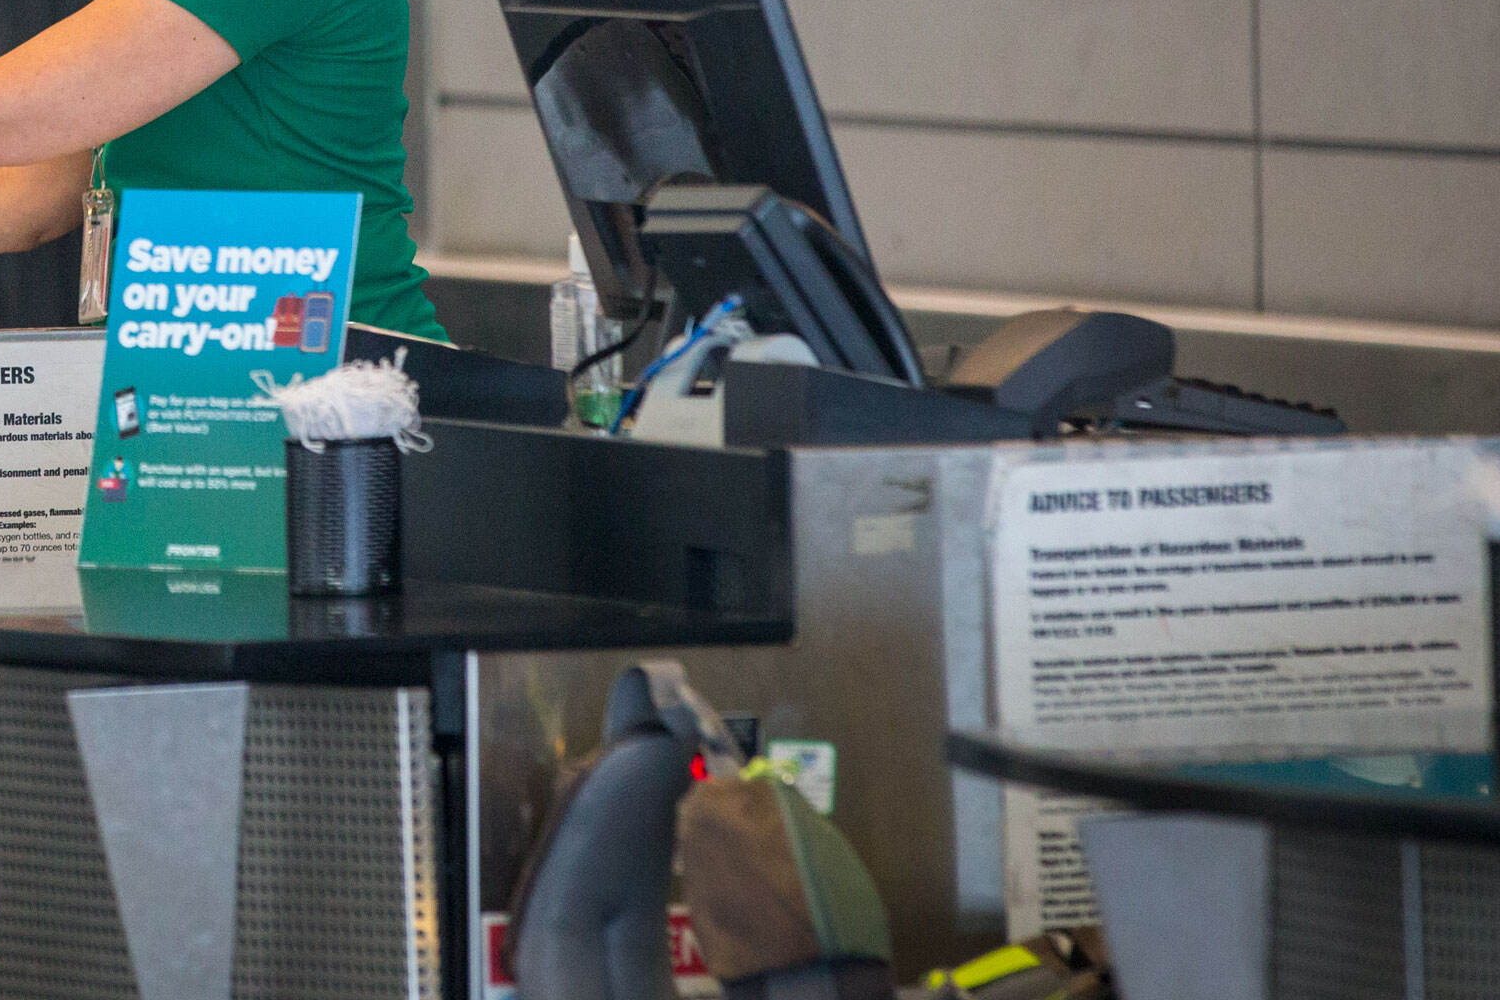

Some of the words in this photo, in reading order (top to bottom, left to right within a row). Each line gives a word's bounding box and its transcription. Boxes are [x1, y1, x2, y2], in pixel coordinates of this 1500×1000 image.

[126, 238, 212, 273] Save
[216, 246, 338, 282] money
[122, 282, 169, 311] on
[172, 283, 257, 318] your
[118, 317, 278, 356] carry-on!
[3, 412, 62, 426] Materials
[30, 431, 73, 441] materials
[75, 431, 94, 440] abo
[43, 467, 61, 477] and
[63, 466, 88, 478] penal
[23, 510, 48, 519] gases,
[23, 532, 53, 541] bottles,
[55, 531, 71, 539] and
[9, 544, 18, 552] to
[21, 544, 30, 552] 70
[32, 543, 62, 552] ounces
